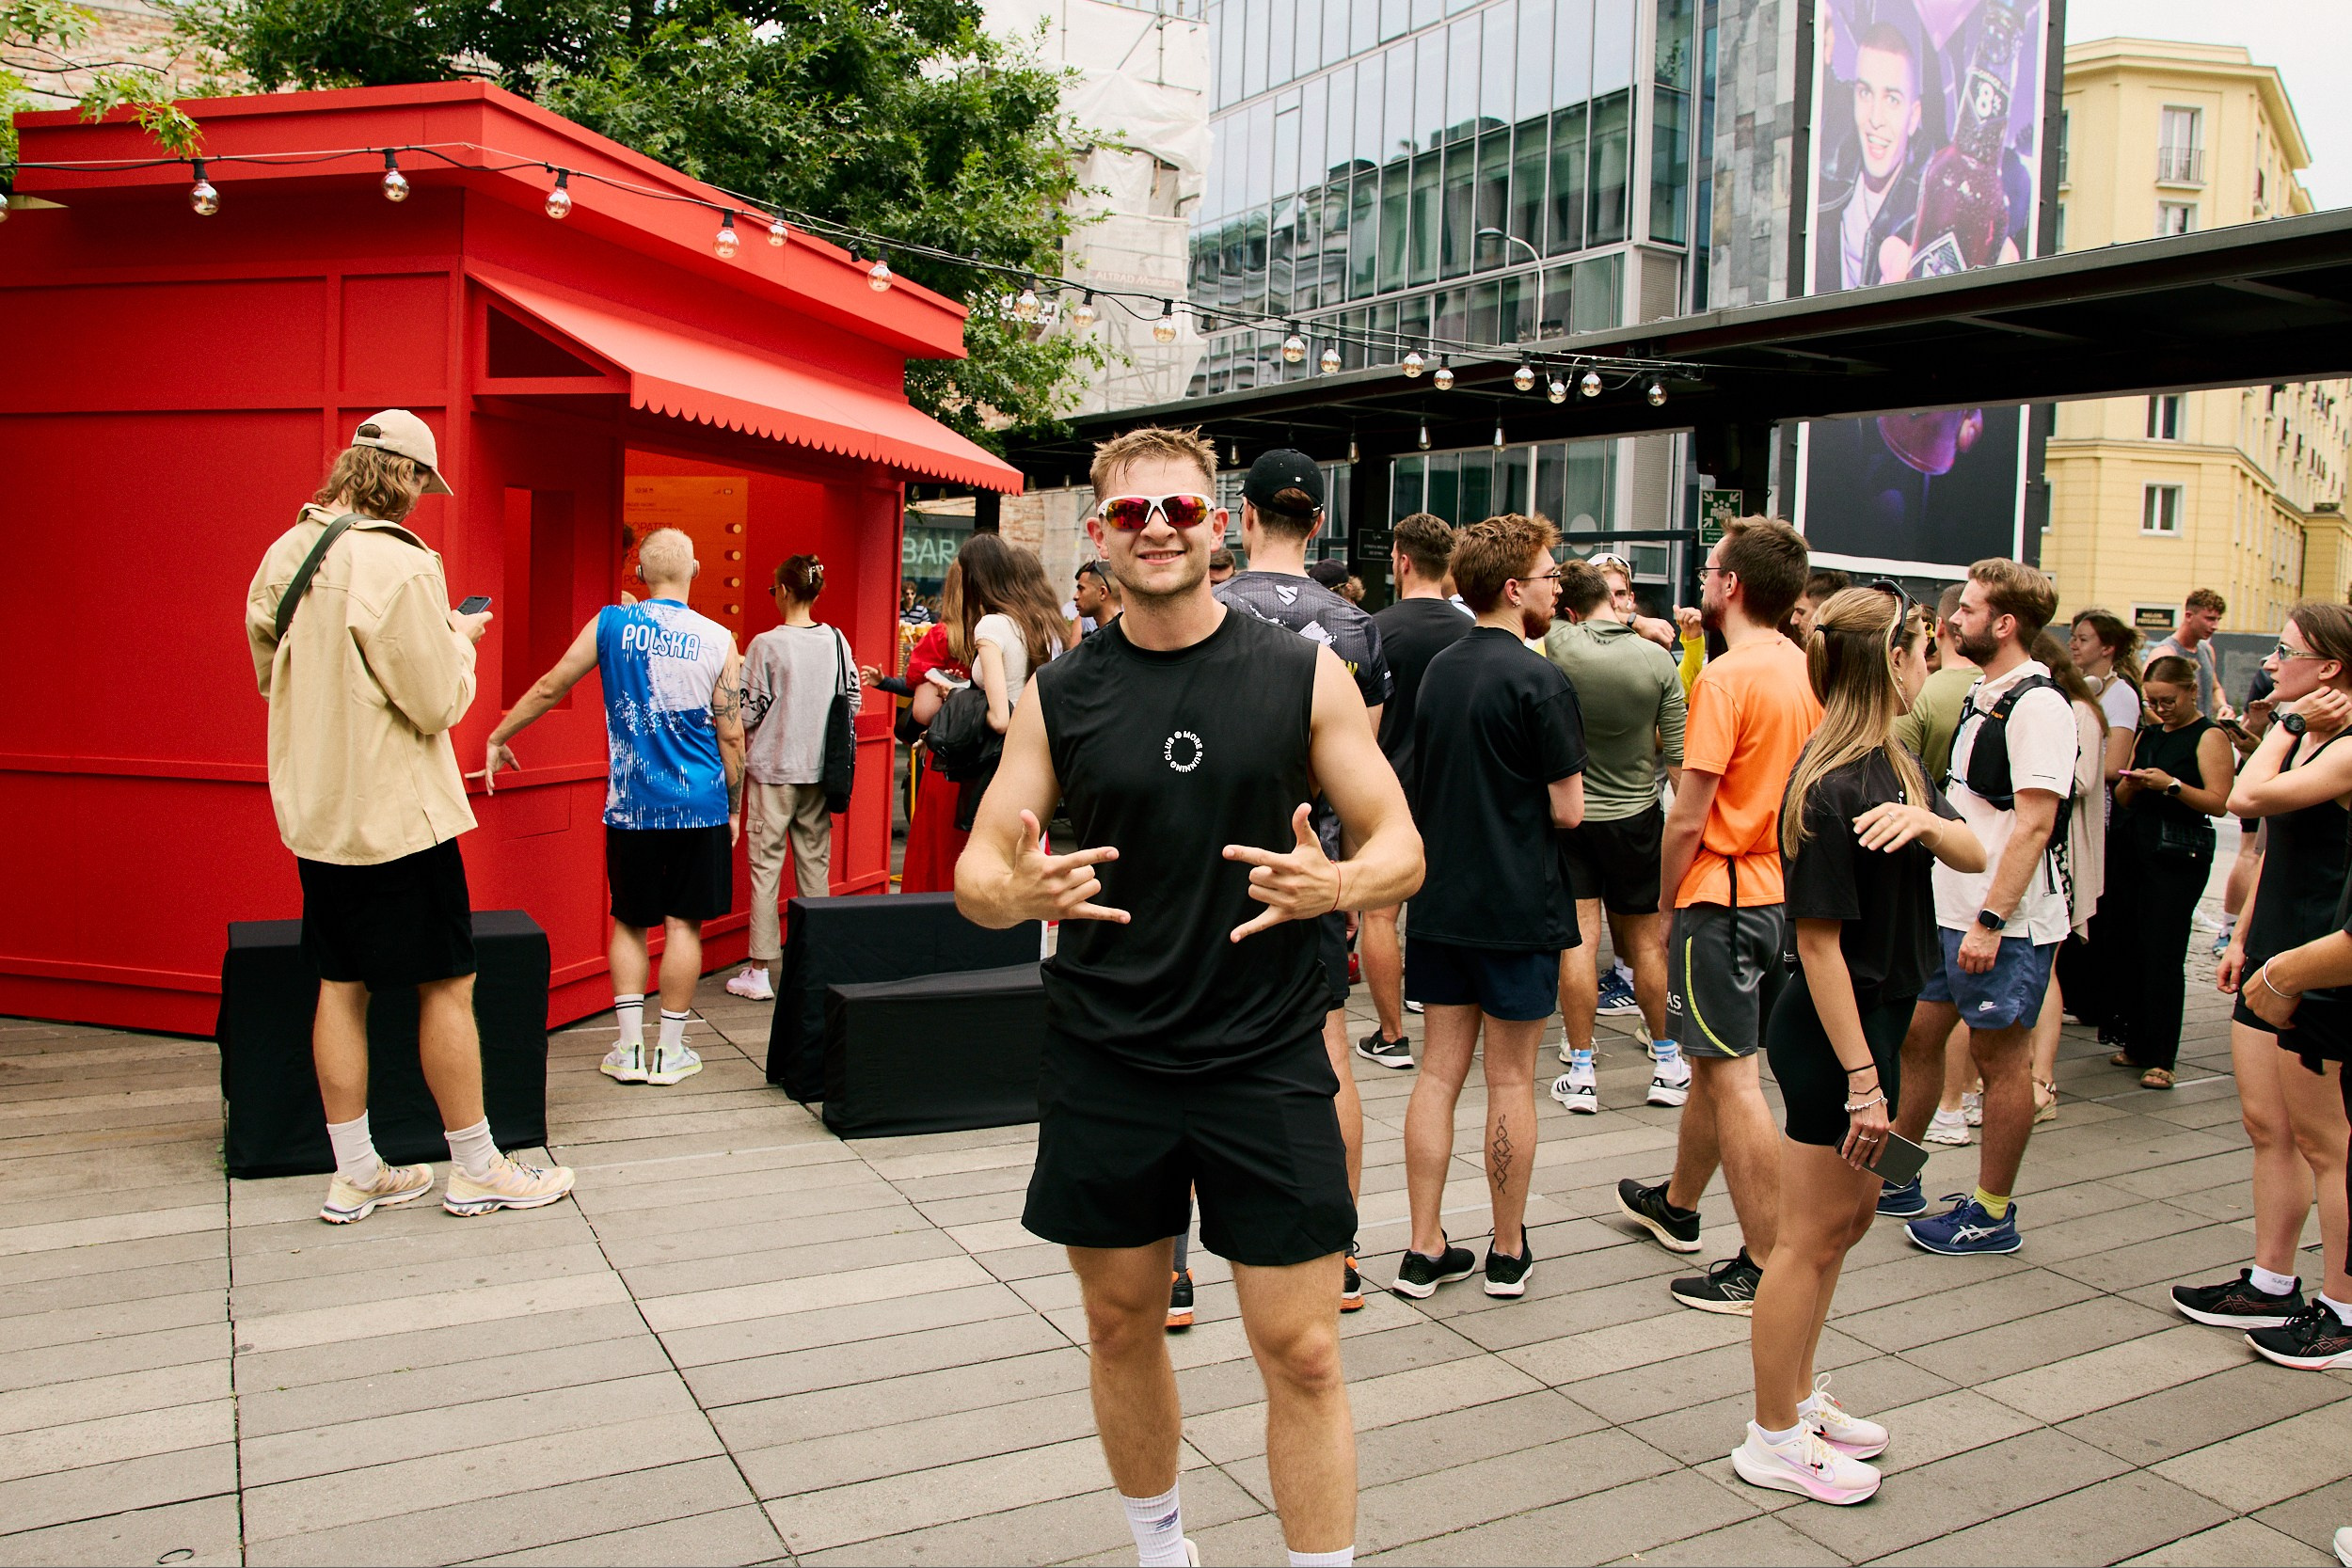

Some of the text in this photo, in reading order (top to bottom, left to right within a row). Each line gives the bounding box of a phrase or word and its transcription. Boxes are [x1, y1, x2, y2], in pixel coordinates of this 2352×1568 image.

[1095, 271, 1136, 284] ALTRAD
[621, 623, 701, 660] POLSKA
[1164, 731, 1203, 772] MORE RUNNING CLUB
